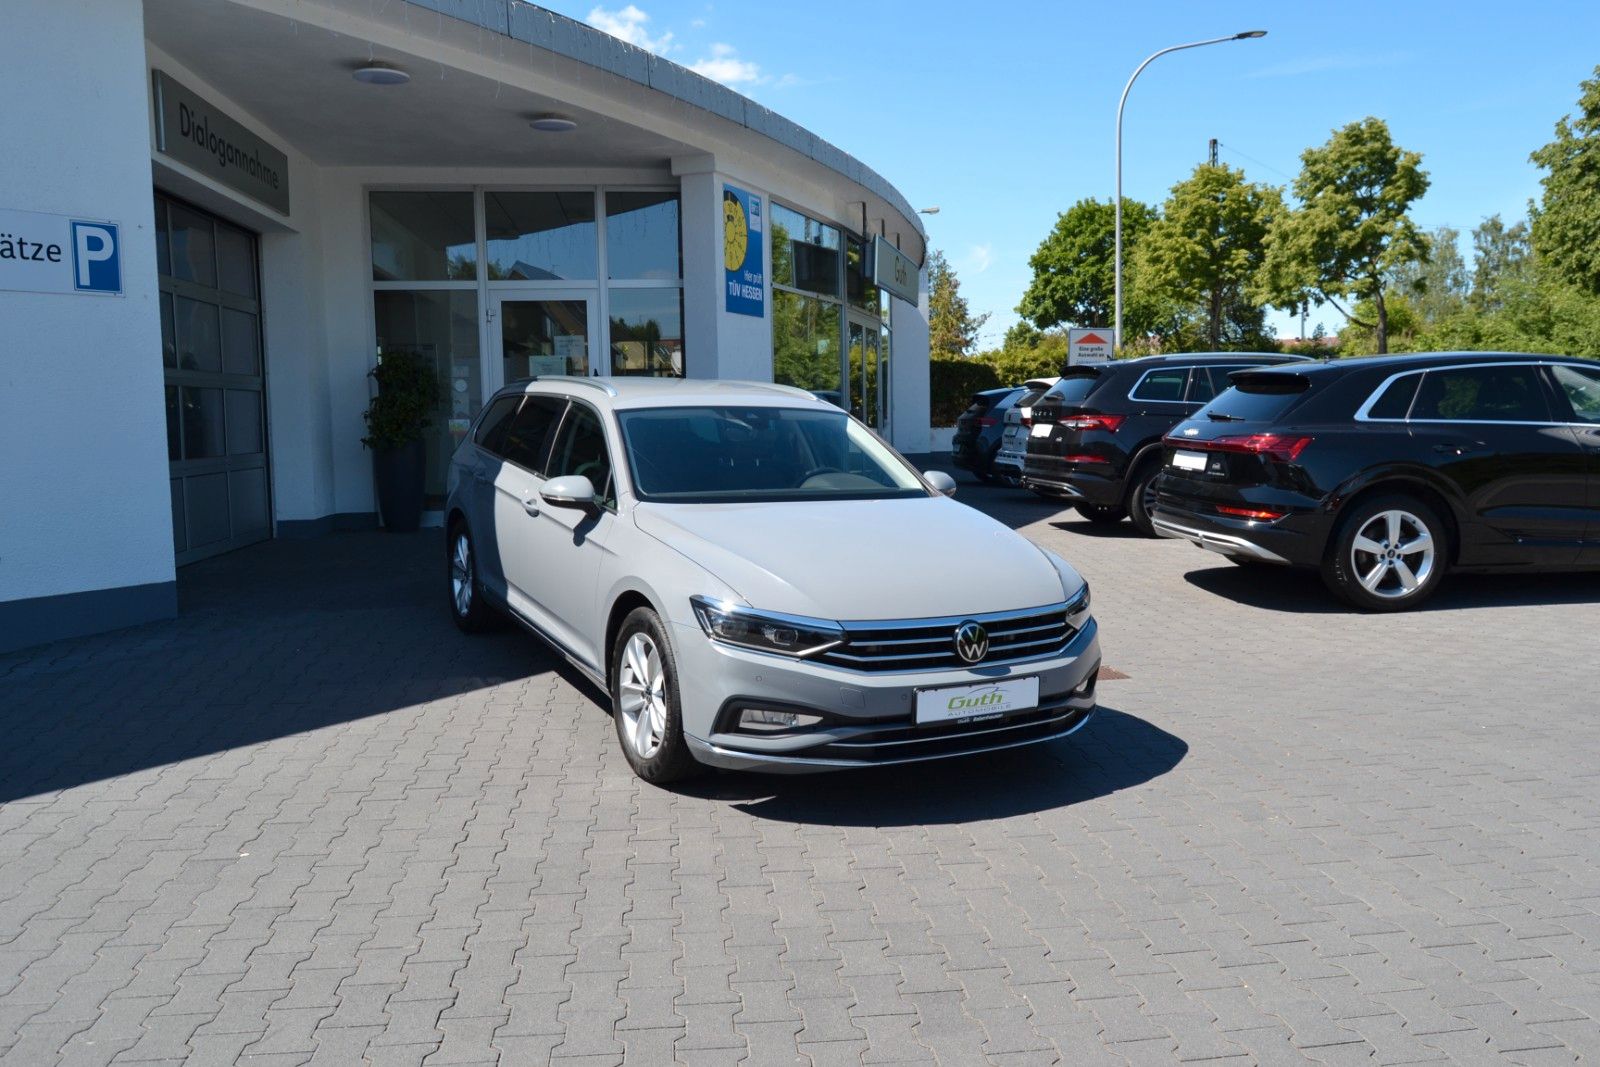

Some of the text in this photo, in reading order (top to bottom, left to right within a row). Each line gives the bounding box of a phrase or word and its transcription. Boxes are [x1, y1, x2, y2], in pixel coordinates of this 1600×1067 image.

[179, 102, 279, 189] Dialogannahme
[75, 225, 114, 287] P
[728, 280, 763, 301] TÜV HESSEN
[948, 693, 1003, 710] Guth
